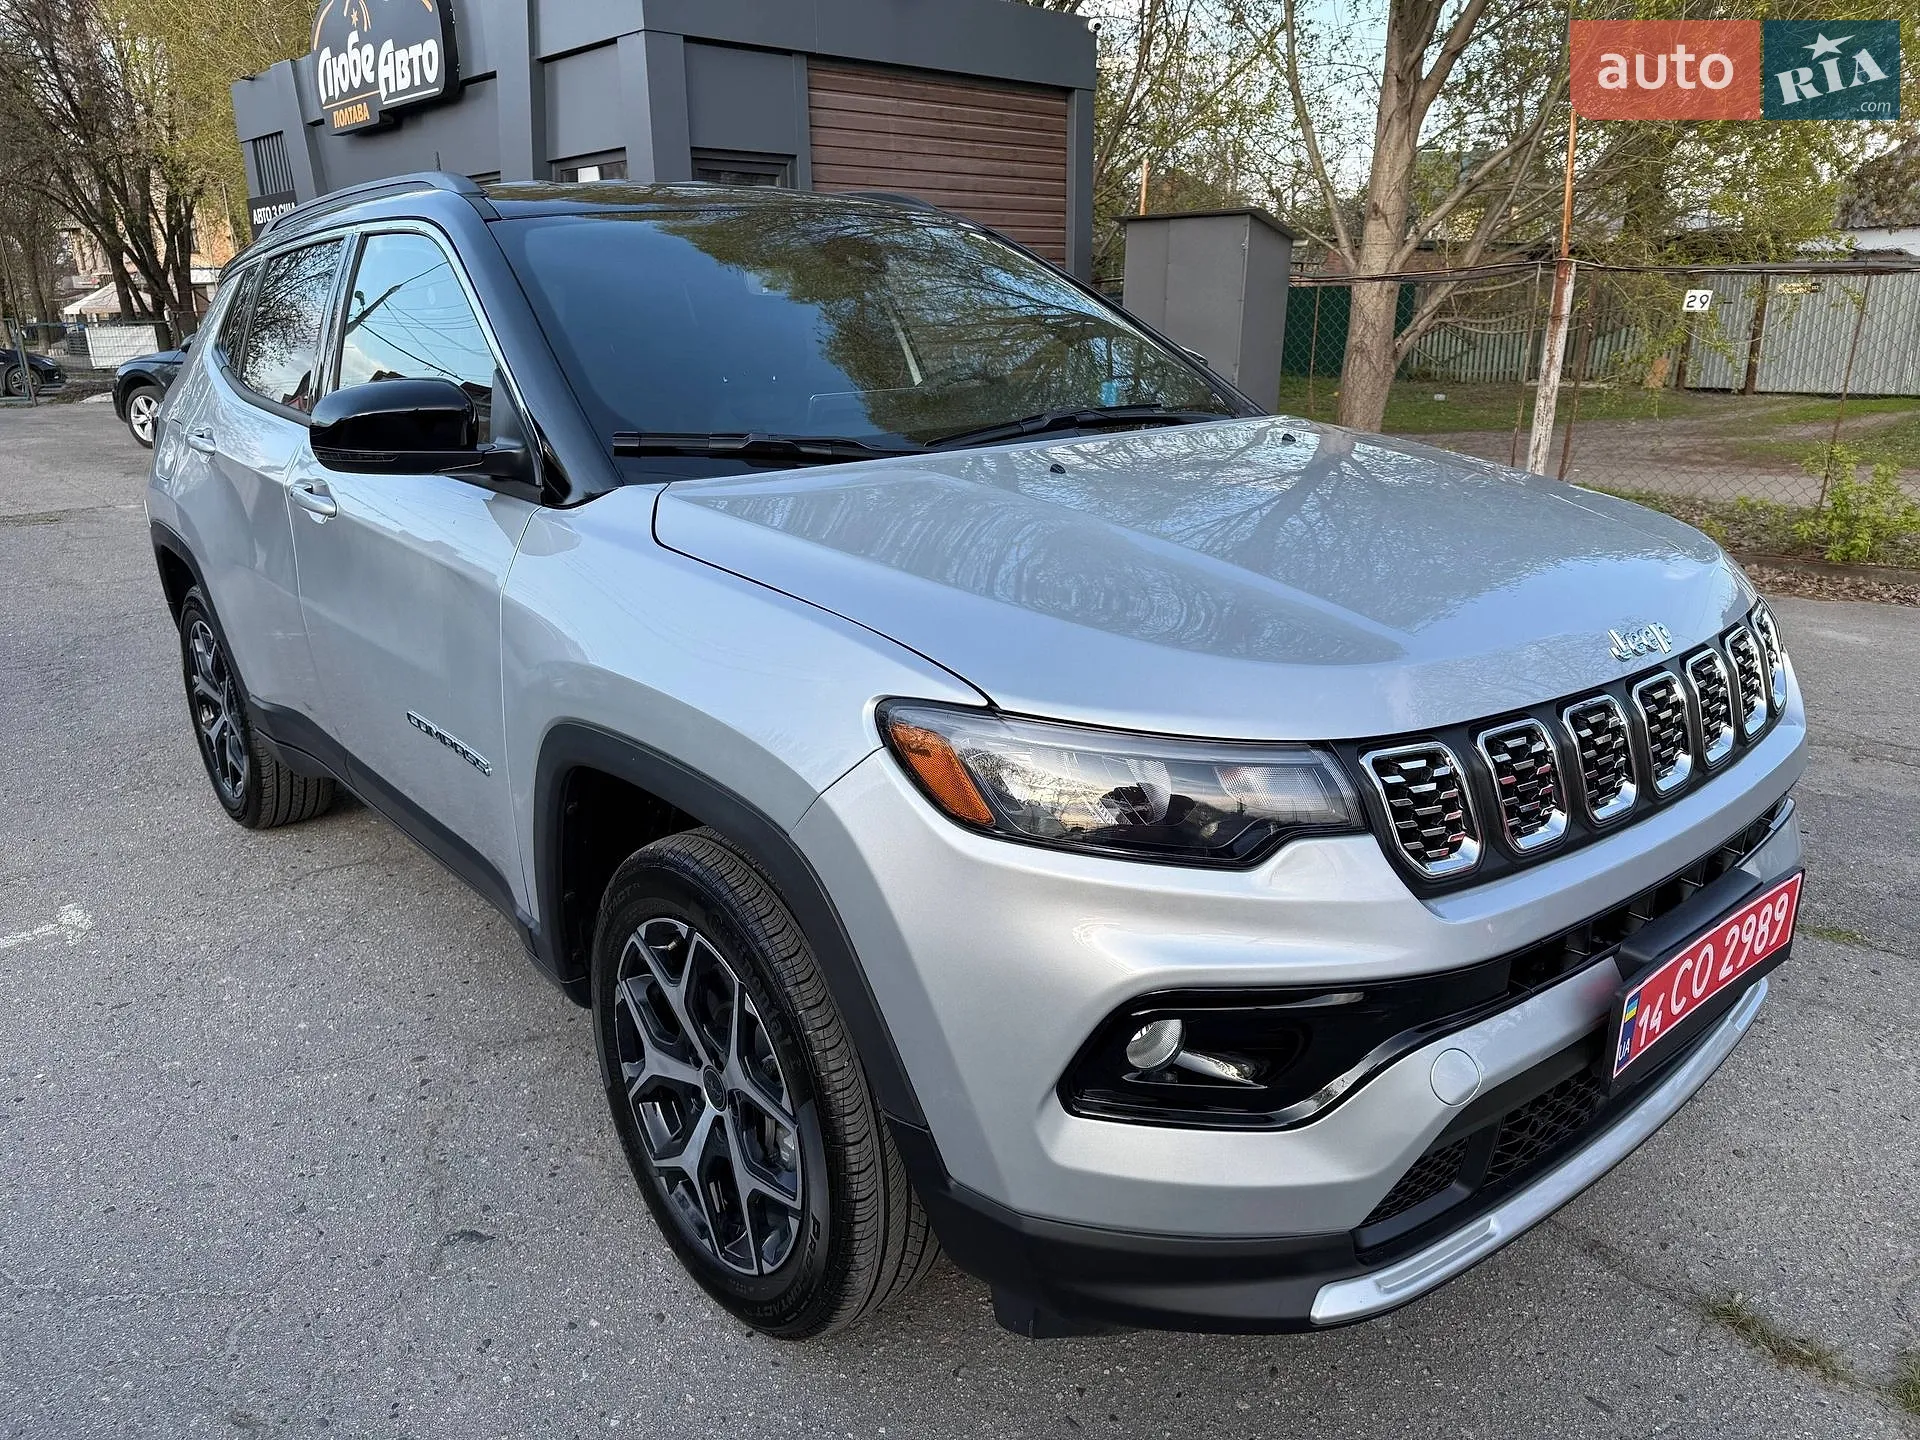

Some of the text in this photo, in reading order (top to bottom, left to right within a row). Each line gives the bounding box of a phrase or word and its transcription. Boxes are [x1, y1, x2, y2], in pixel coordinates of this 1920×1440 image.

[318, 30, 375, 105] Любе
[333, 102, 370, 129] ПОЛТАВА
[253, 206, 272, 225] АВТО
[1686, 294, 1710, 309] 29
[1608, 622, 1672, 662] Jeep
[406, 710, 492, 776] COMPASS
[1638, 892, 1789, 1047] 14 CO 2989
[1618, 1040, 1631, 1061] UA
